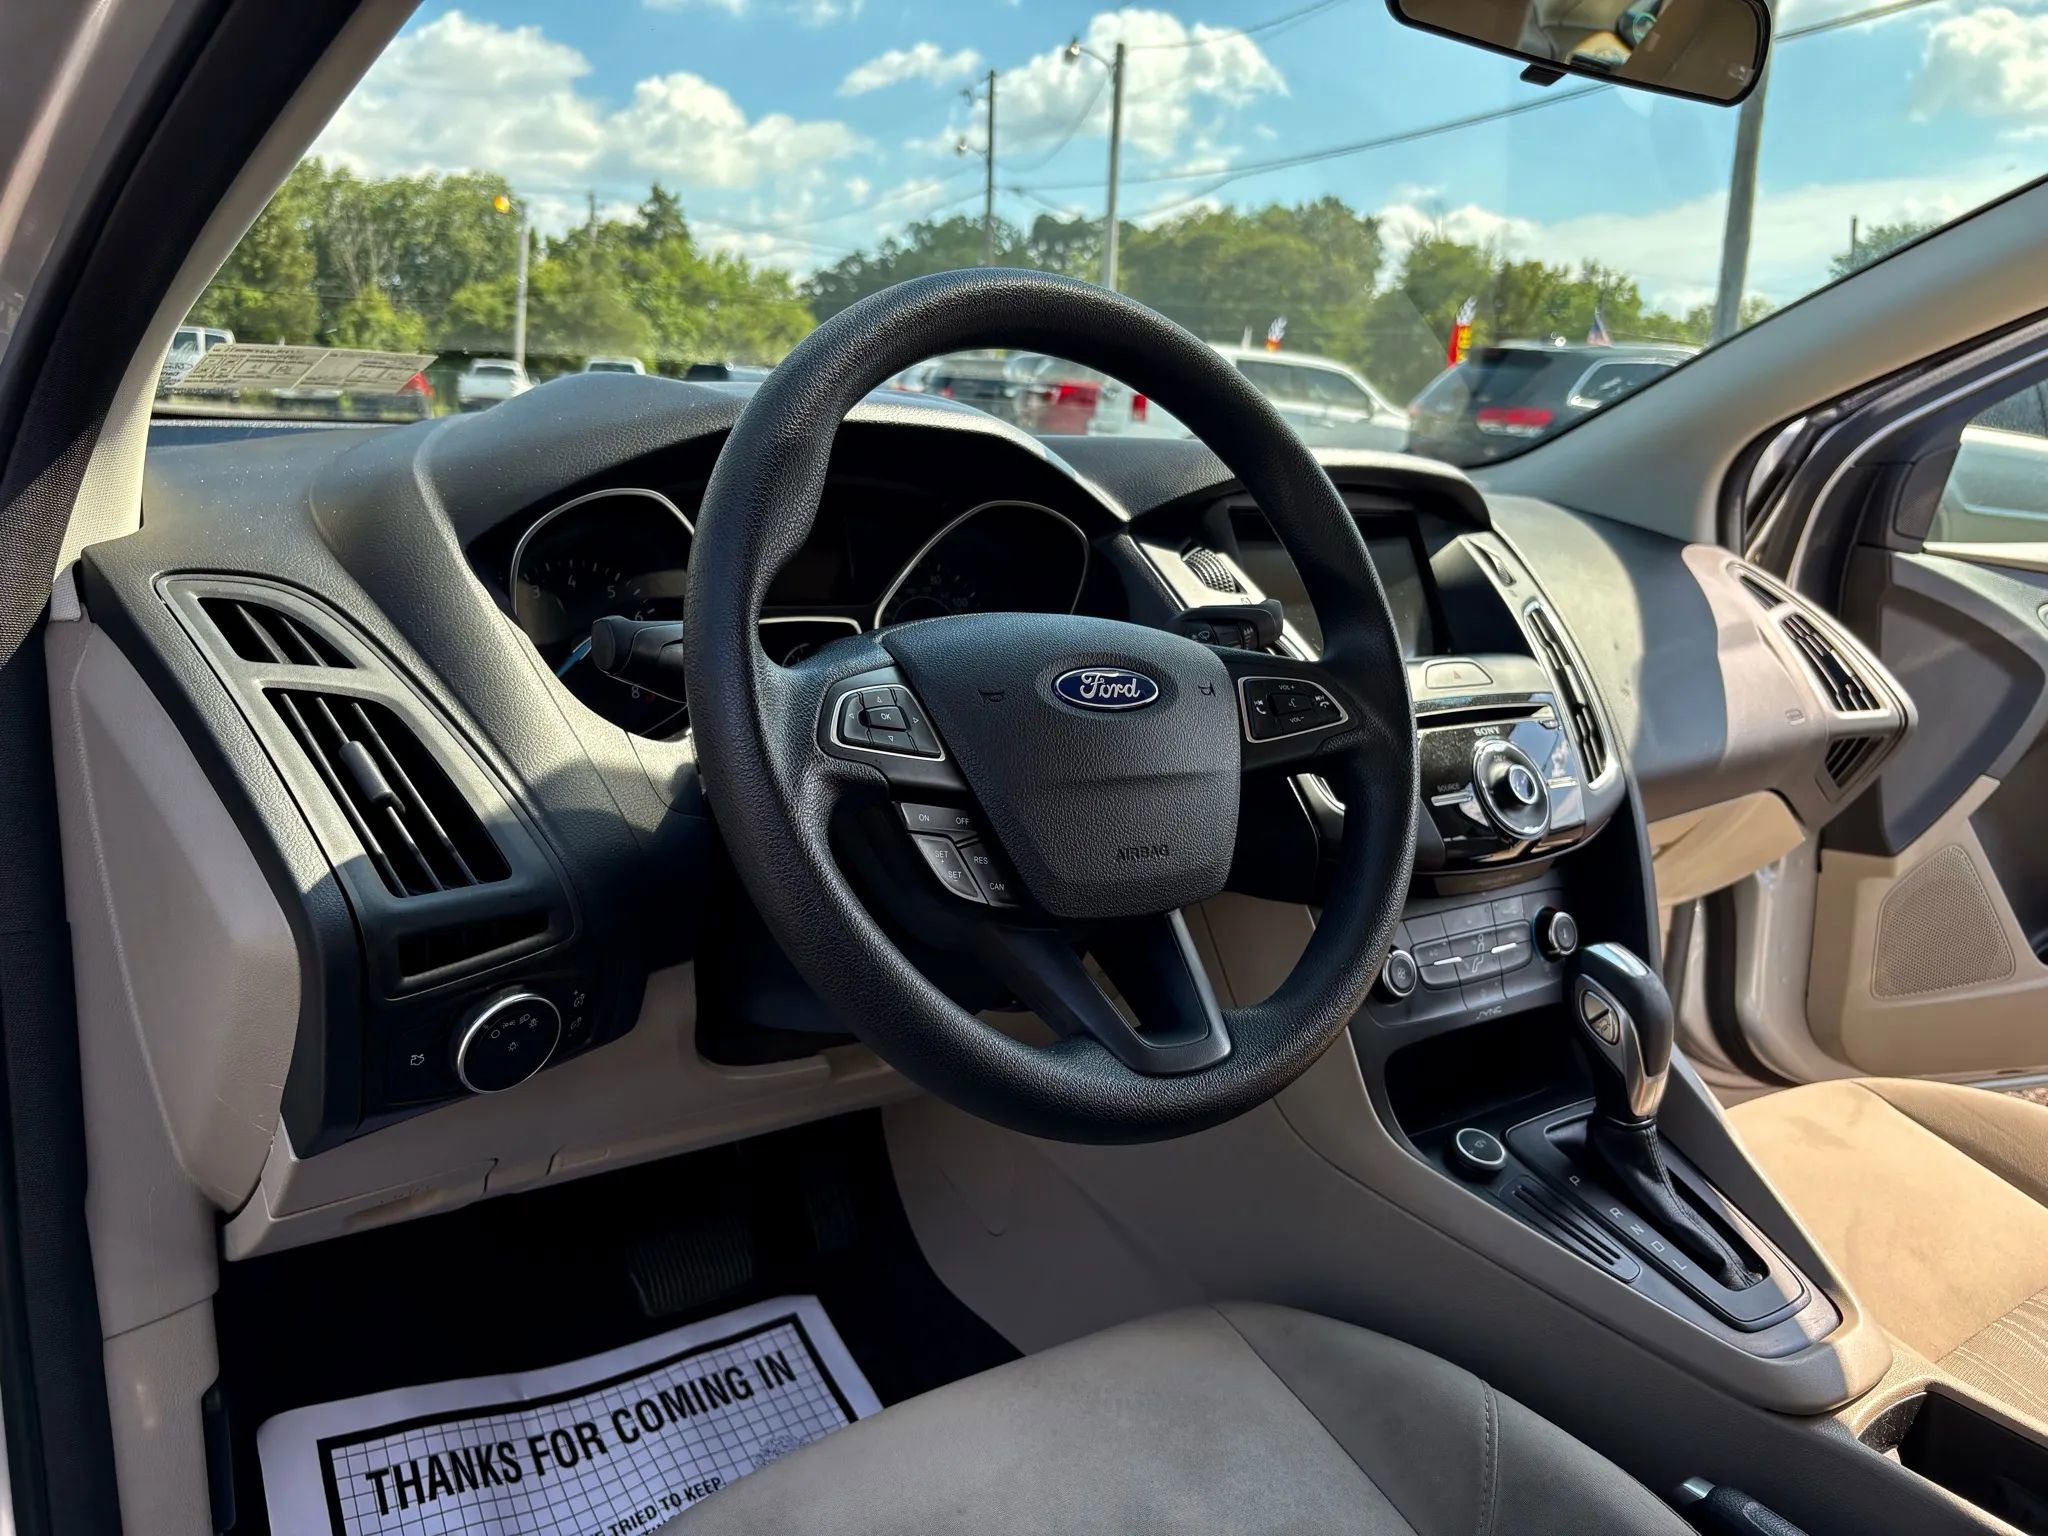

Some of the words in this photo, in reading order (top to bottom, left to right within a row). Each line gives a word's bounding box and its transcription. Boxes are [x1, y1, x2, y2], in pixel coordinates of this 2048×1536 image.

[607, 585, 616, 599] 5
[1080, 672, 1141, 699] Ford
[880, 712, 892, 721] OK
[1473, 726, 1500, 737] SONY
[918, 814, 930, 822] ON
[955, 817, 969, 825] OFF
[934, 850, 949, 858] SET
[1115, 844, 1169, 861] AIRBAG
[973, 856, 989, 865] RES
[947, 870, 962, 879] SET
[989, 882, 1005, 891] CAN
[1569, 1175, 1581, 1186] P
[1609, 1207, 1624, 1219] R
[1630, 1223, 1645, 1236] N
[1650, 1240, 1666, 1253] D
[1672, 1259, 1688, 1270] L
[365, 1441, 523, 1515] THANKS
[528, 1421, 608, 1476] FOR
[611, 1366, 755, 1444] COMING
[753, 1351, 797, 1390] IN
[607, 1505, 658, 1536] TRIED
[659, 1493, 683, 1511] TO
[683, 1477, 722, 1502] KEEP
